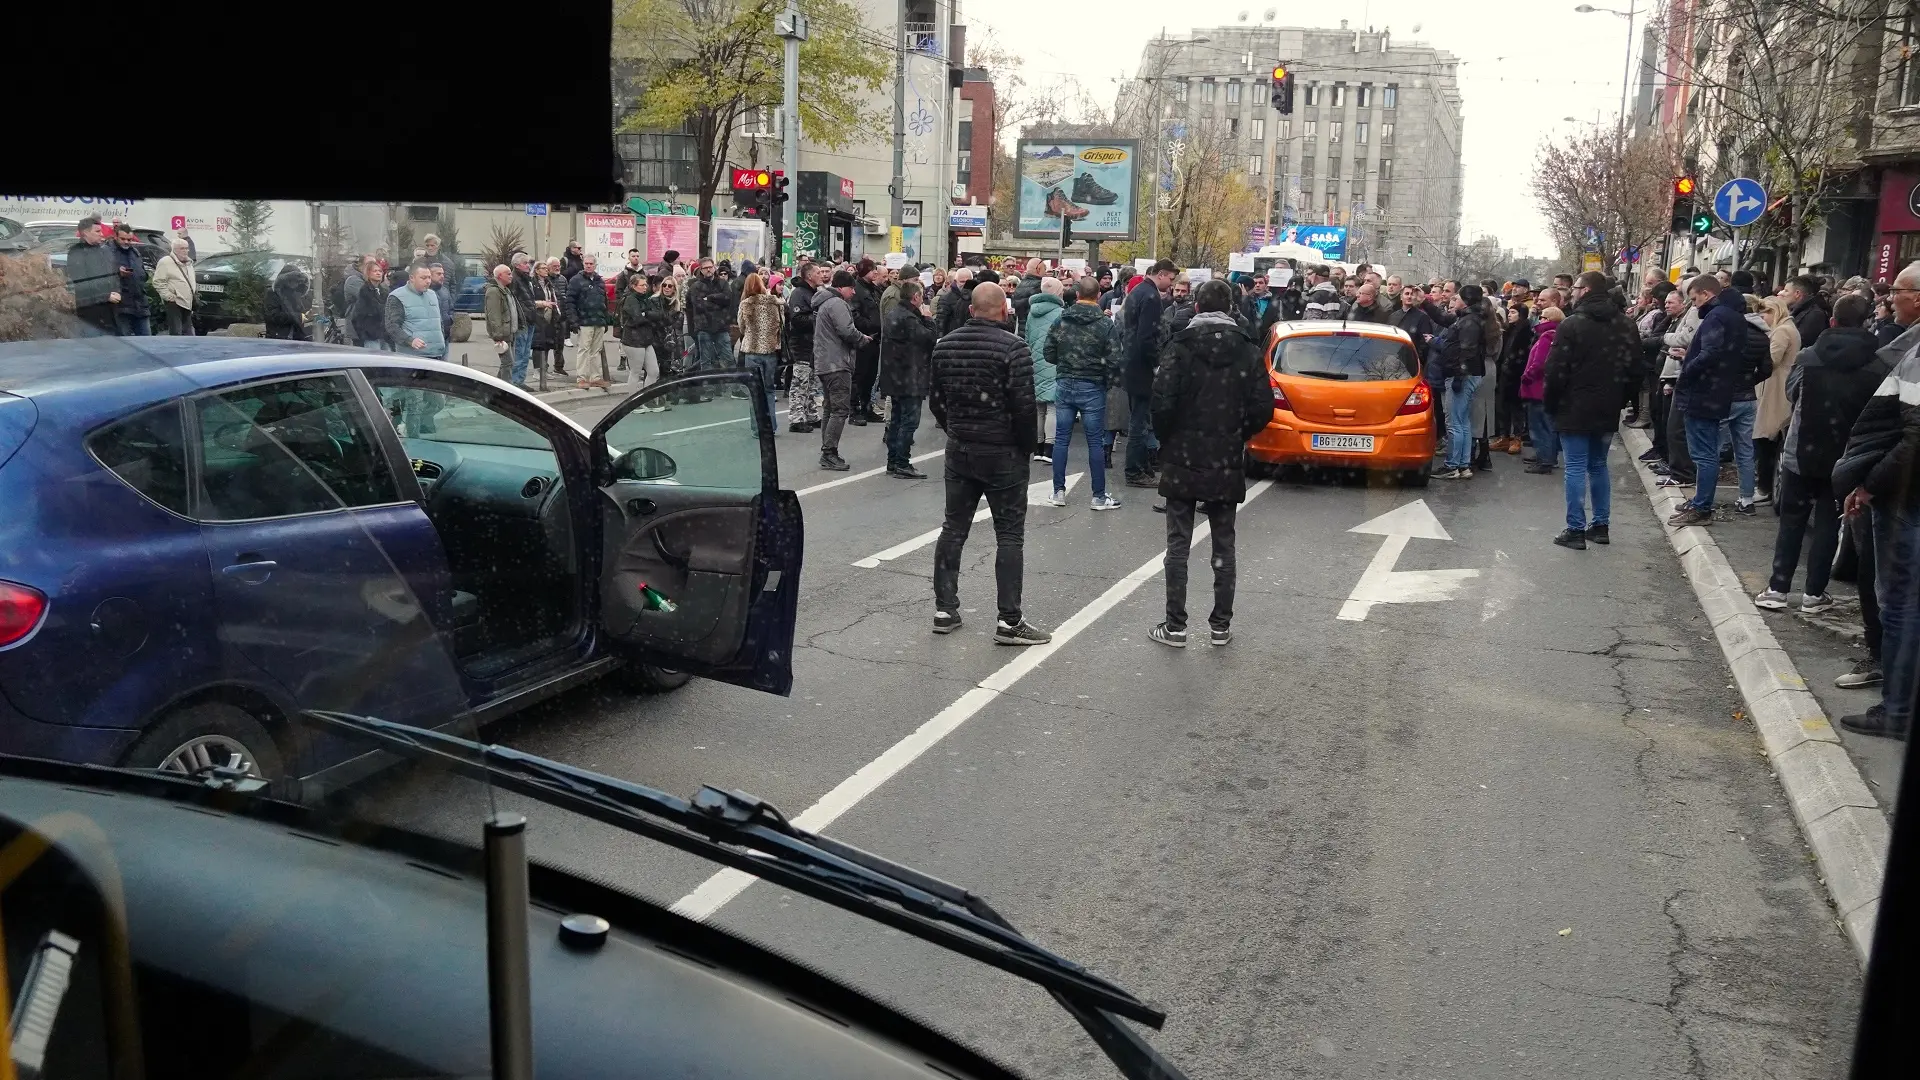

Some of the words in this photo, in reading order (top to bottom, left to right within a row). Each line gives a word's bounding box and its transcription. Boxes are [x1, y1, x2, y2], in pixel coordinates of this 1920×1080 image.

[1084, 151, 1122, 161] Grisport
[738, 173, 753, 186] Moj
[588, 217, 633, 227] КЊИЖАРА
[216, 224, 229, 232] B92
[1311, 232, 1340, 242] SAŠA
[1879, 244, 1891, 274] COSTA
[1320, 437, 1330, 446] BG
